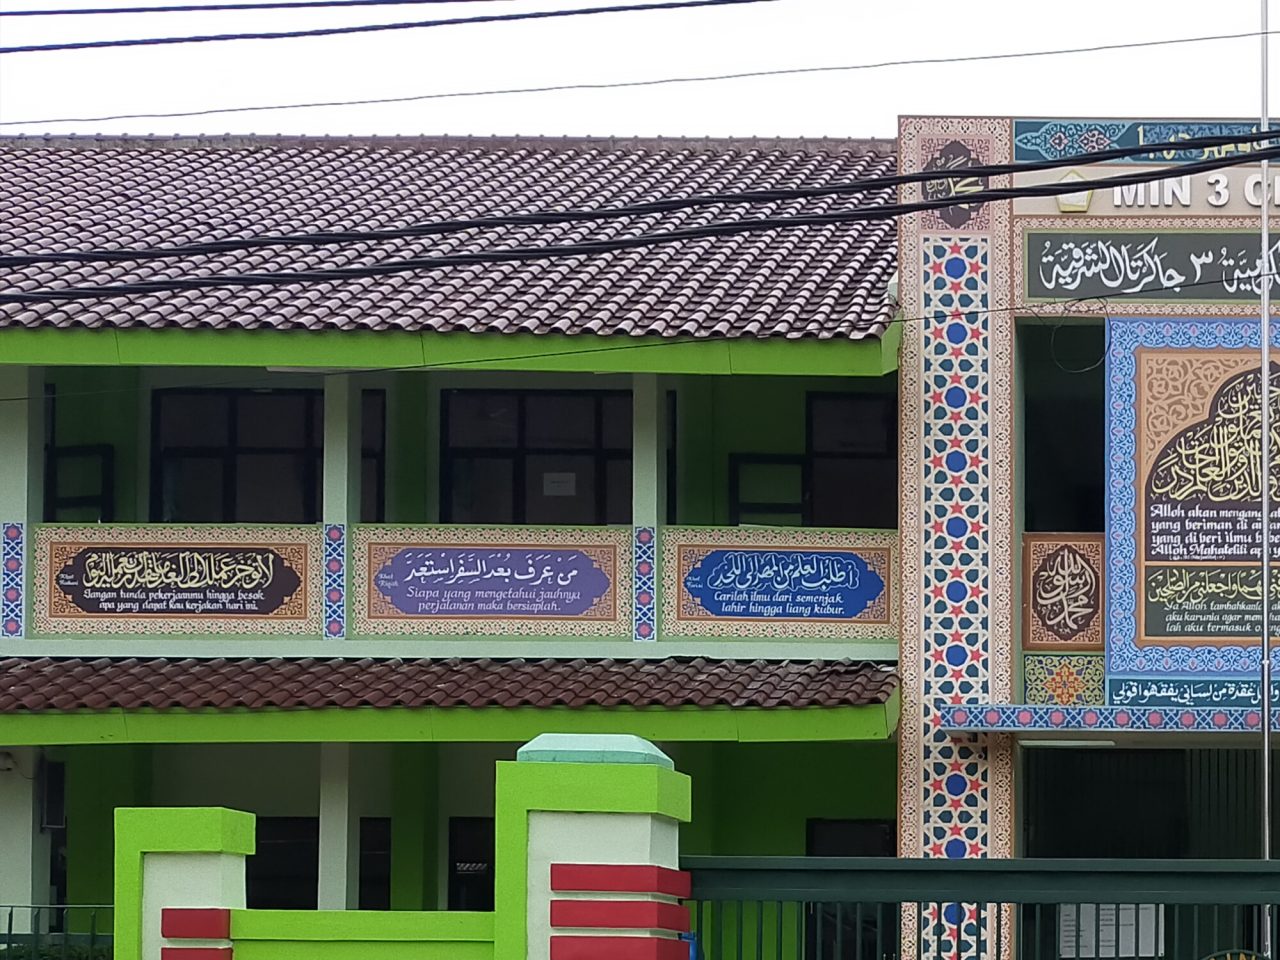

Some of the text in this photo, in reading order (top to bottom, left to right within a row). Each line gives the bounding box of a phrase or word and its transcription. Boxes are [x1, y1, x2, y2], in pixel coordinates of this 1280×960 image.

[1113, 174, 1191, 207] MIN
[1207, 173, 1230, 207] 3
[1150, 503, 1185, 518] Alloh
[1187, 503, 1217, 518] akan
[1151, 520, 1181, 533] yang
[1185, 518, 1233, 530] beriman
[1236, 518, 1248, 530] di
[1151, 534, 1181, 547] yang
[1225, 532, 1252, 544] ilmu
[1151, 543, 1187, 555] Alloh
[206, 589, 235, 603] hingga
[237, 589, 265, 600] besok
[406, 586, 581, 604] Siapa yang mengetahui jauhnya
[714, 590, 844, 605] Carilah ilmu dari semenjak
[99, 601, 115, 612] apa
[117, 601, 139, 613] yang
[142, 600, 167, 612] dapat
[185, 600, 223, 614] kerjakan
[225, 600, 243, 610] hari
[418, 600, 561, 614] perjalanan maka bersiaplah.
[722, 602, 846, 617] lahir hingga liang kubur.
[1164, 600, 1179, 611] Ya
[1165, 611, 1183, 622] aku
[1183, 611, 1220, 622] karunia
[1221, 614, 1242, 625] agar
[1166, 622, 1181, 632] lah
[1184, 622, 1204, 632] aku
[1207, 622, 1252, 632] termasuk
